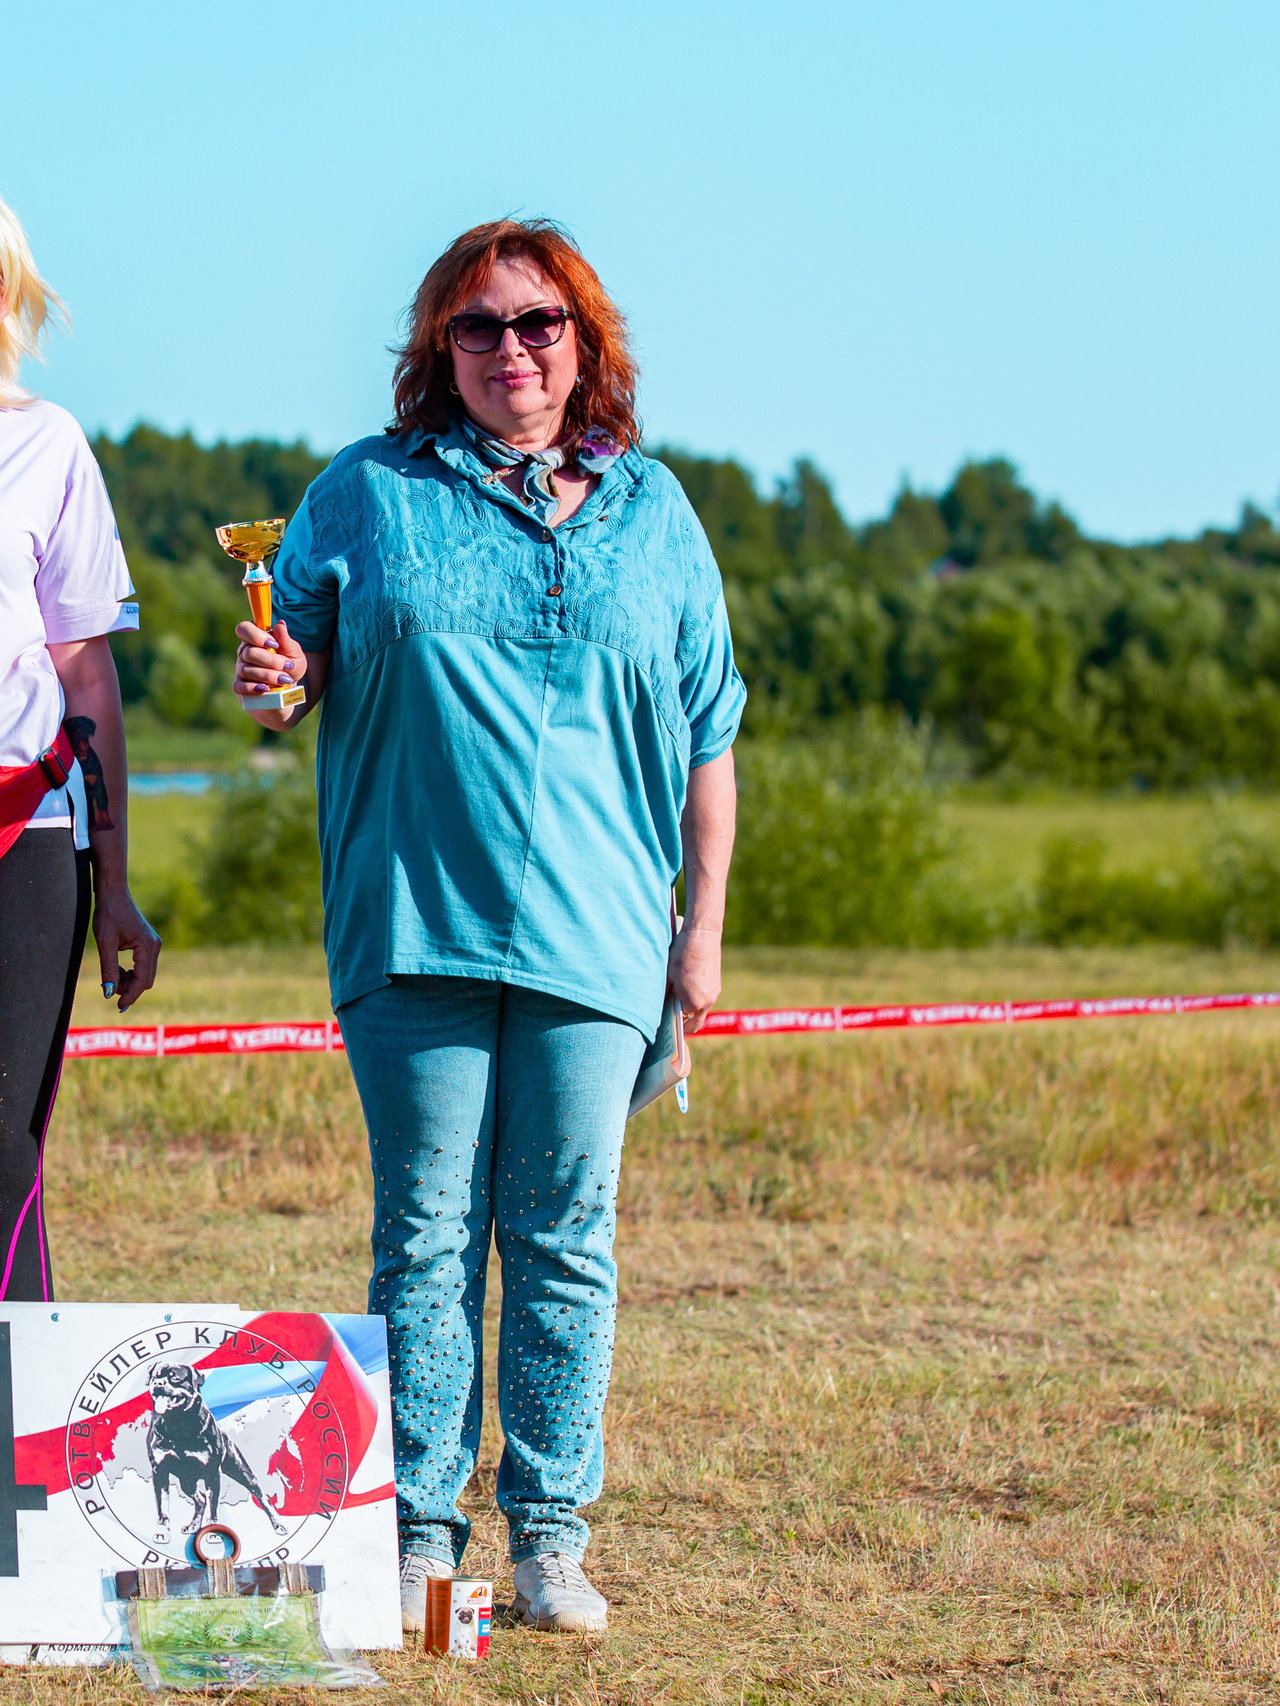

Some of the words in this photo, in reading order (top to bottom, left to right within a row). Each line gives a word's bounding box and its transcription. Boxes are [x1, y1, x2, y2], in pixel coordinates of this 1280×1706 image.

[230, 1028, 324, 1049] ТРАПЕЗА
[71, 1331, 172, 1516] РОТВЕЙЛЕР
[194, 1326, 289, 1370] КЛУБ
[296, 1378, 344, 1522] РОССИИ
